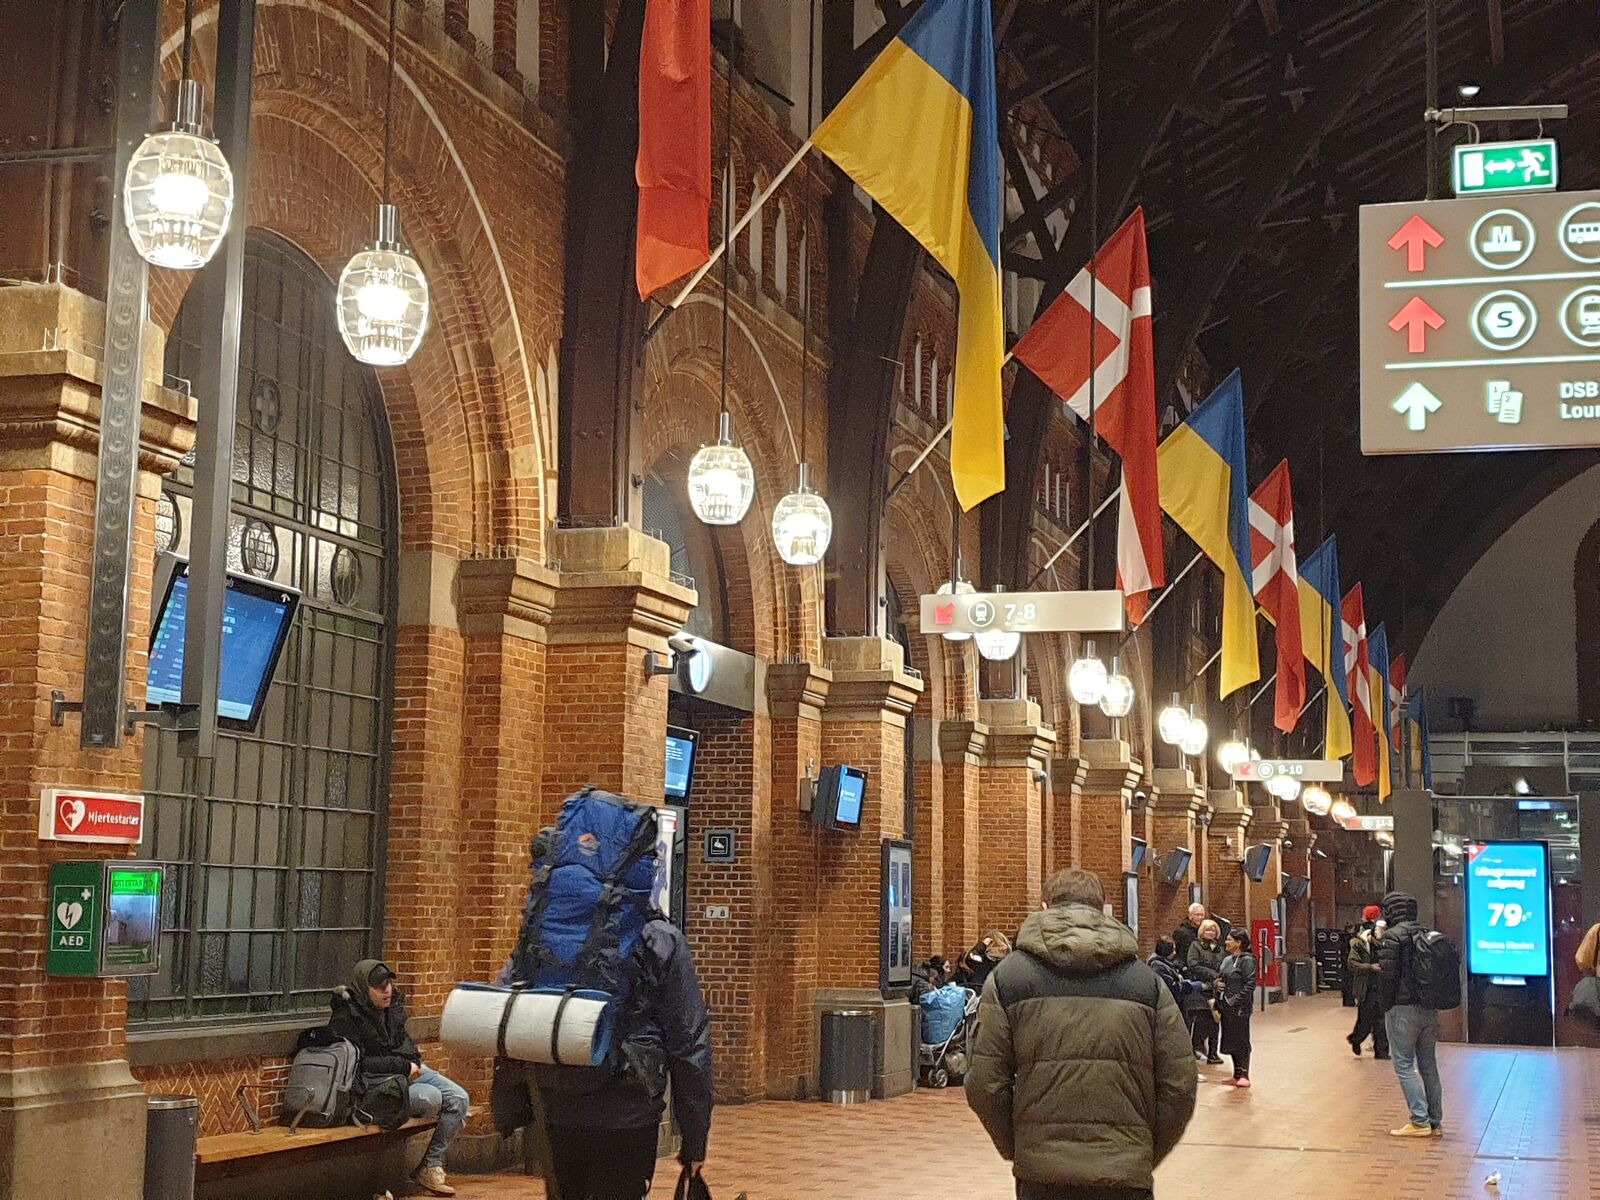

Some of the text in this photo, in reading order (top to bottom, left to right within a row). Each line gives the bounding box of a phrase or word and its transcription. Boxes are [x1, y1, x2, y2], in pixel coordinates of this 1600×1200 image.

[1496, 310, 1514, 328] S
[1561, 381, 1599, 399] DSB
[1004, 603, 1036, 621] 7-8
[88, 811, 139, 825] Hjertestarter
[59, 935, 84, 946] AED
